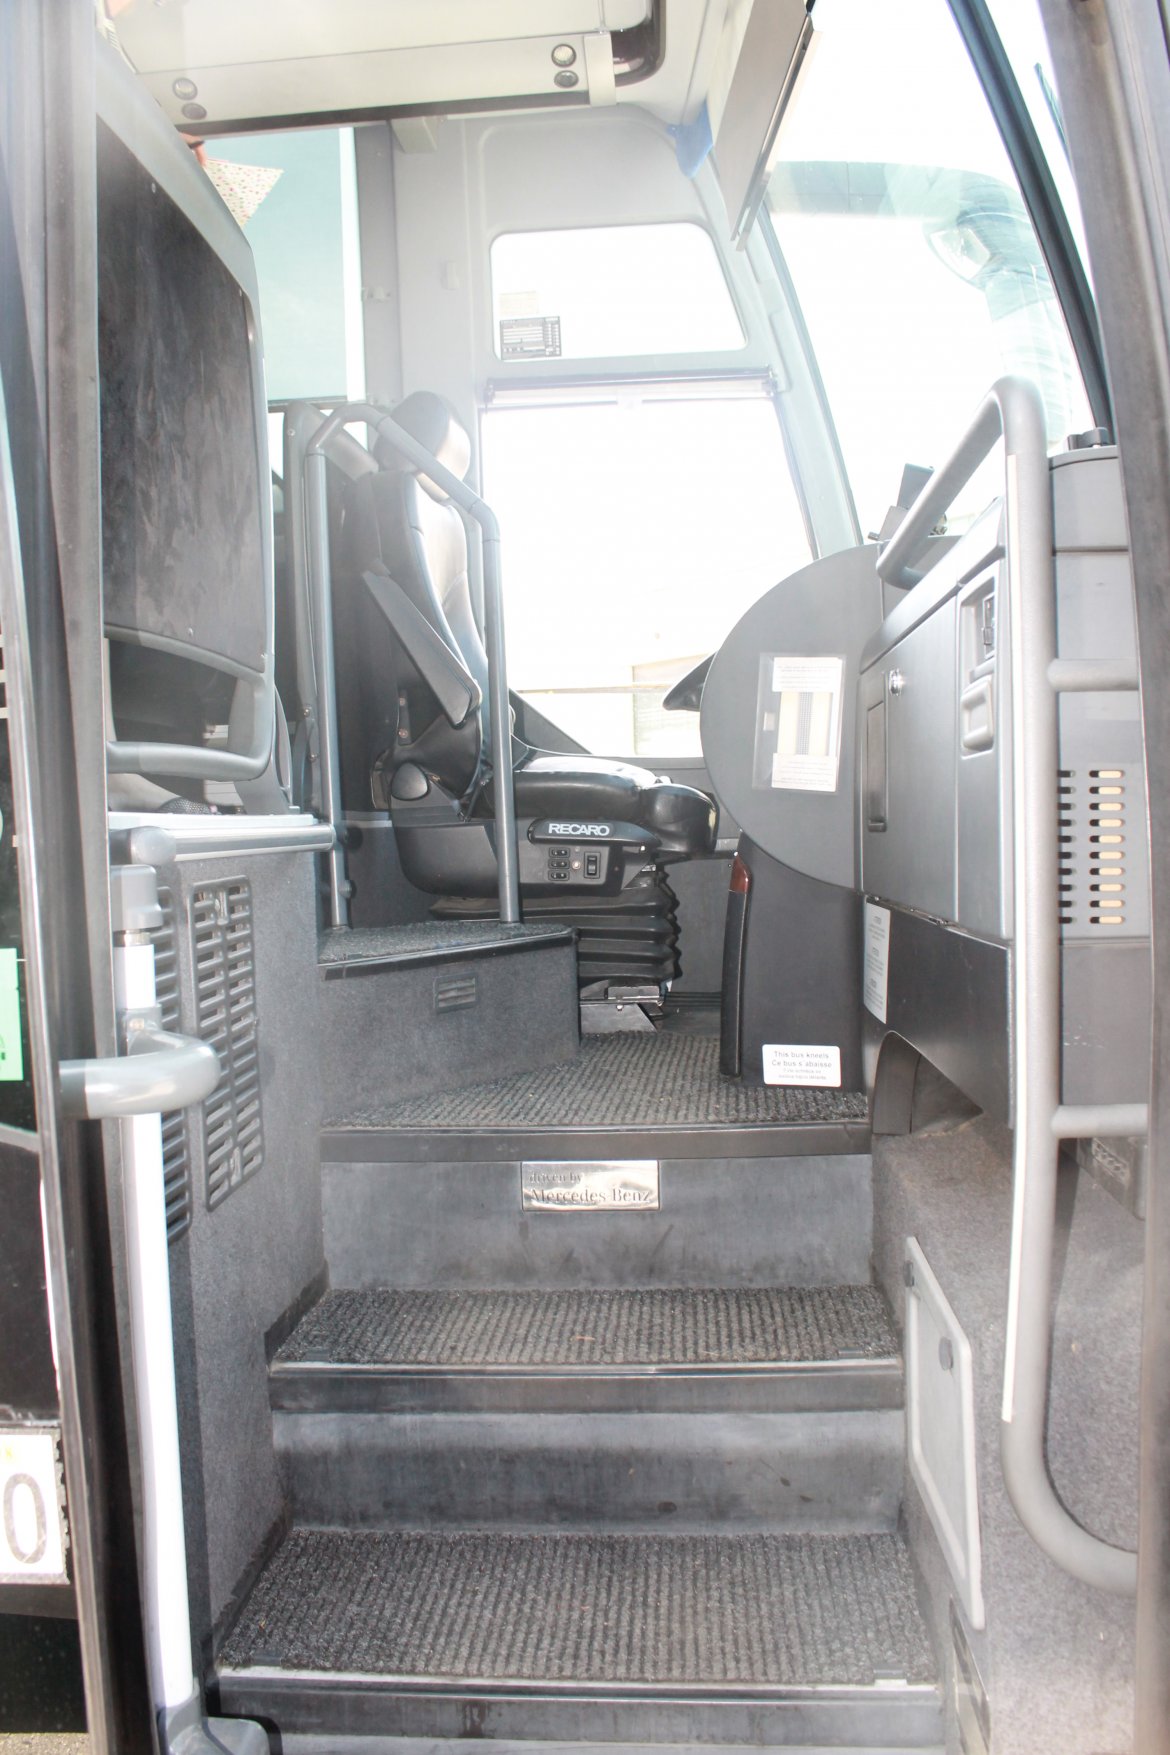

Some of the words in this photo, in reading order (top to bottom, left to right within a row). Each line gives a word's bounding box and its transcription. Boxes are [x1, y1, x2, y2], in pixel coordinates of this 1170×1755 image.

[548, 823, 610, 836] RECARO
[774, 1050, 789, 1058] This
[791, 1051, 804, 1059] bus
[806, 1052, 829, 1060] kneels
[529, 1172, 566, 1183] driven
[570, 1172, 582, 1183] by
